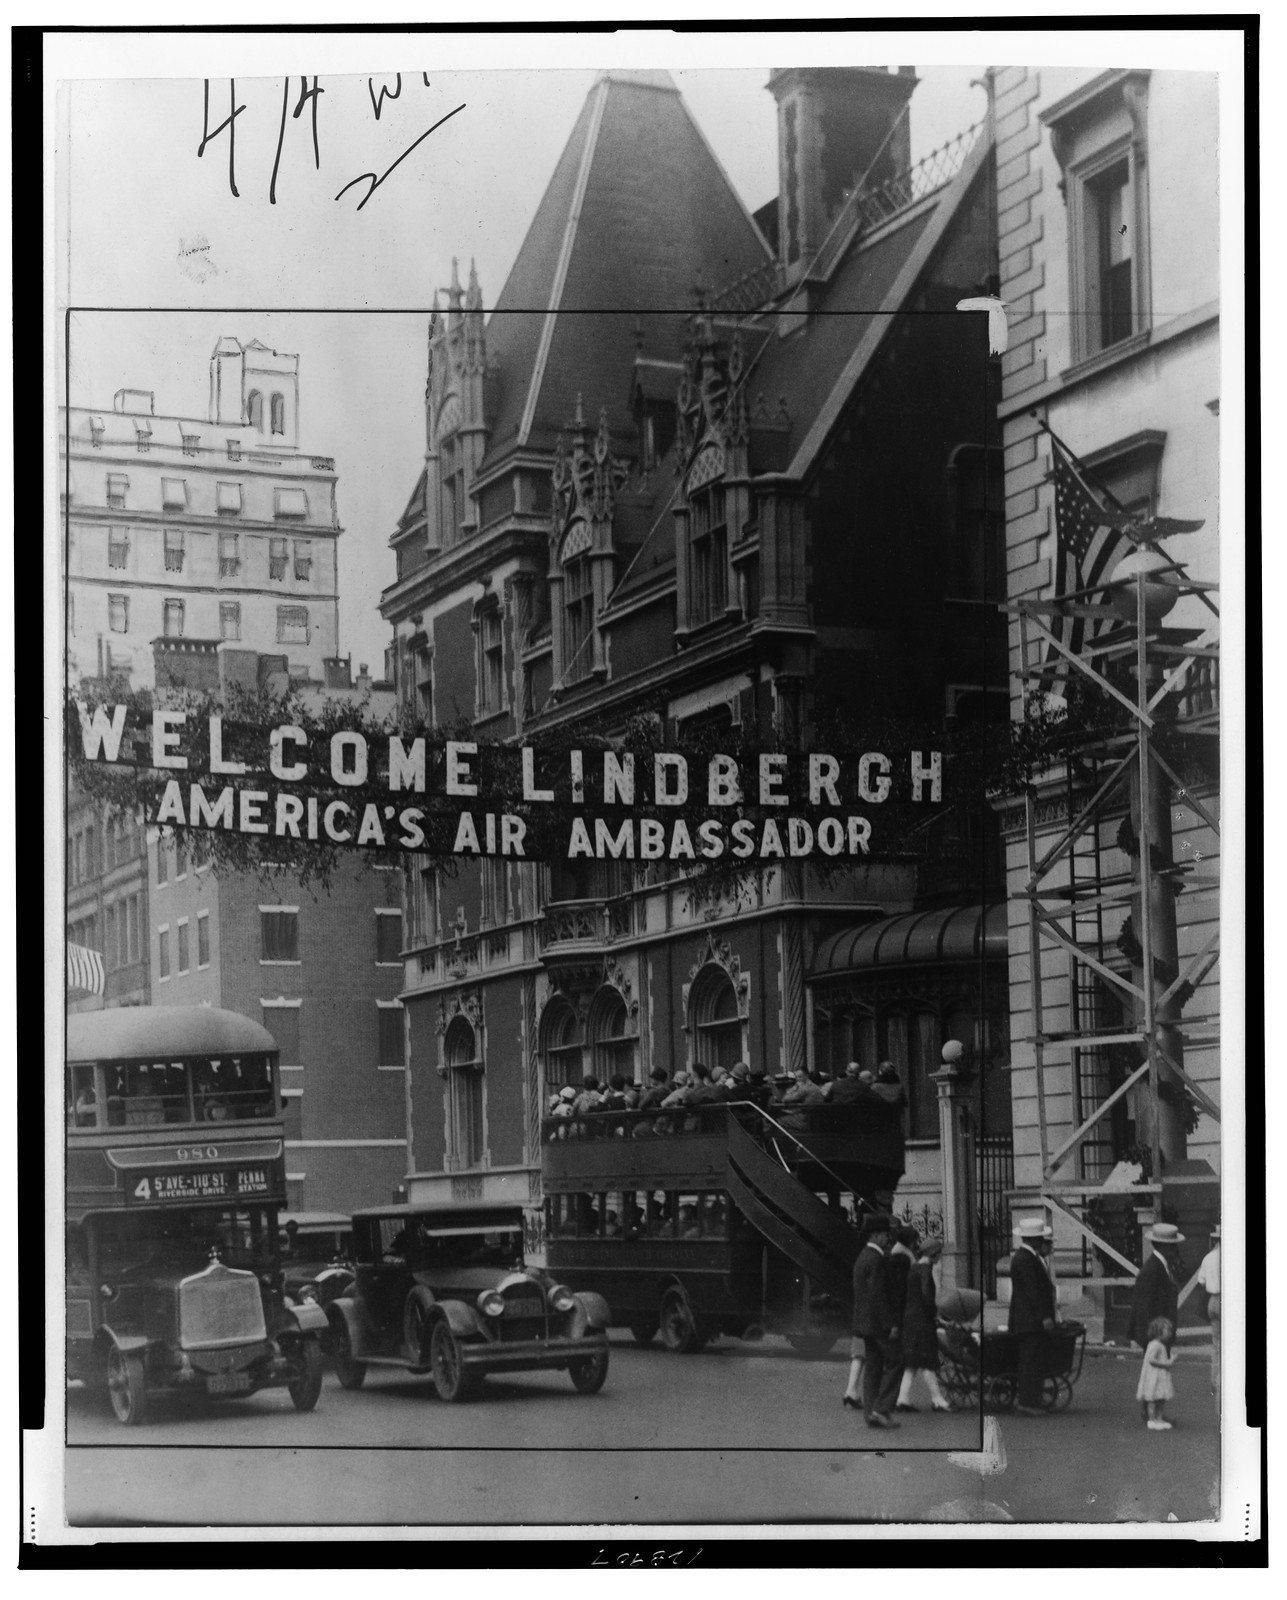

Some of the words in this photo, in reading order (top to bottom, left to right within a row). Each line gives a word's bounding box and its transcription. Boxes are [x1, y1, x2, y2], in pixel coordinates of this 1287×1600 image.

[75, 701, 479, 797] WELCOME
[521, 745, 943, 807] LINDBERGH
[156, 779, 426, 849] AMERICA'S
[453, 810, 528, 857] AIR
[567, 814, 873, 860] AMBASSADOR
[176, 1146, 218, 1161] 980
[134, 1177, 151, 1200] 4
[158, 1188, 199, 1198] RIVERSIDE
[202, 1186, 226, 1196] DRIVE
[238, 1183, 268, 1193] STATION
